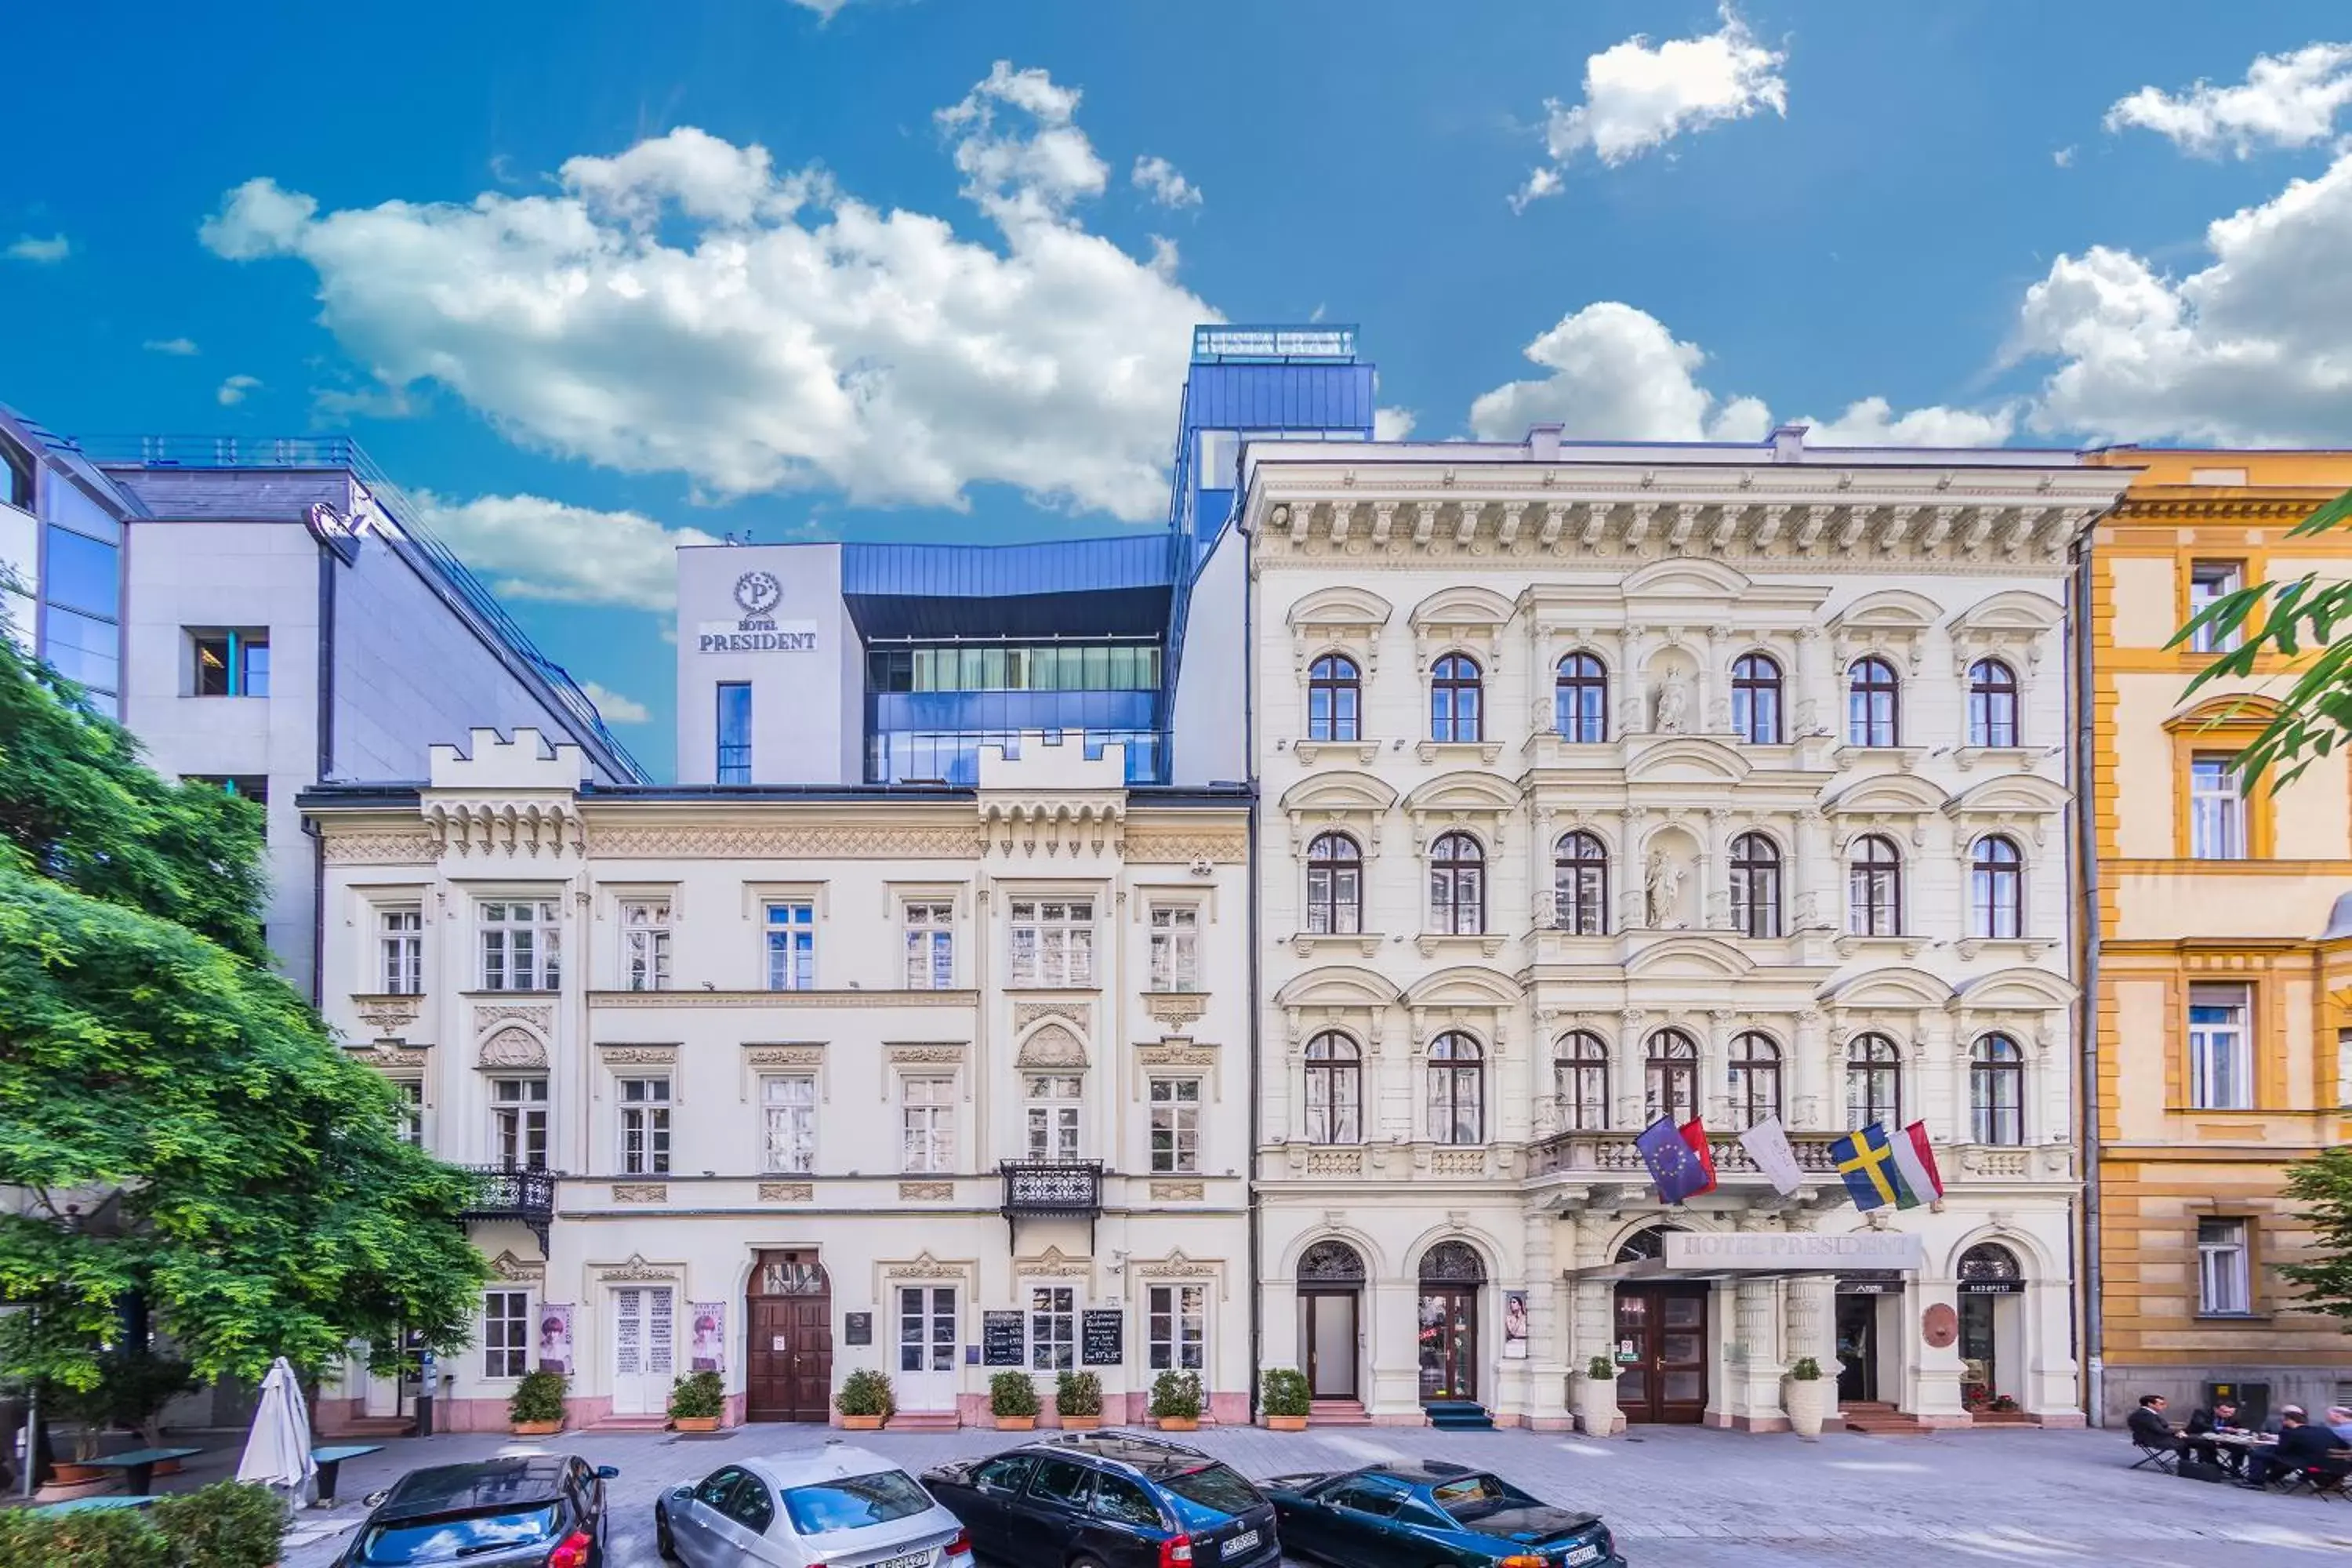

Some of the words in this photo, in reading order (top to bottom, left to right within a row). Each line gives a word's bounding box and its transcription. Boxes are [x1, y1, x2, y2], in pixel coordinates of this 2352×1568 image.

[751, 583, 768, 604] P
[739, 620, 777, 631] HOTEL
[700, 633, 815, 652] PRESIDENT
[1683, 1236, 1764, 1255] HOTEL
[1770, 1236, 1907, 1255] PRESIDENT
